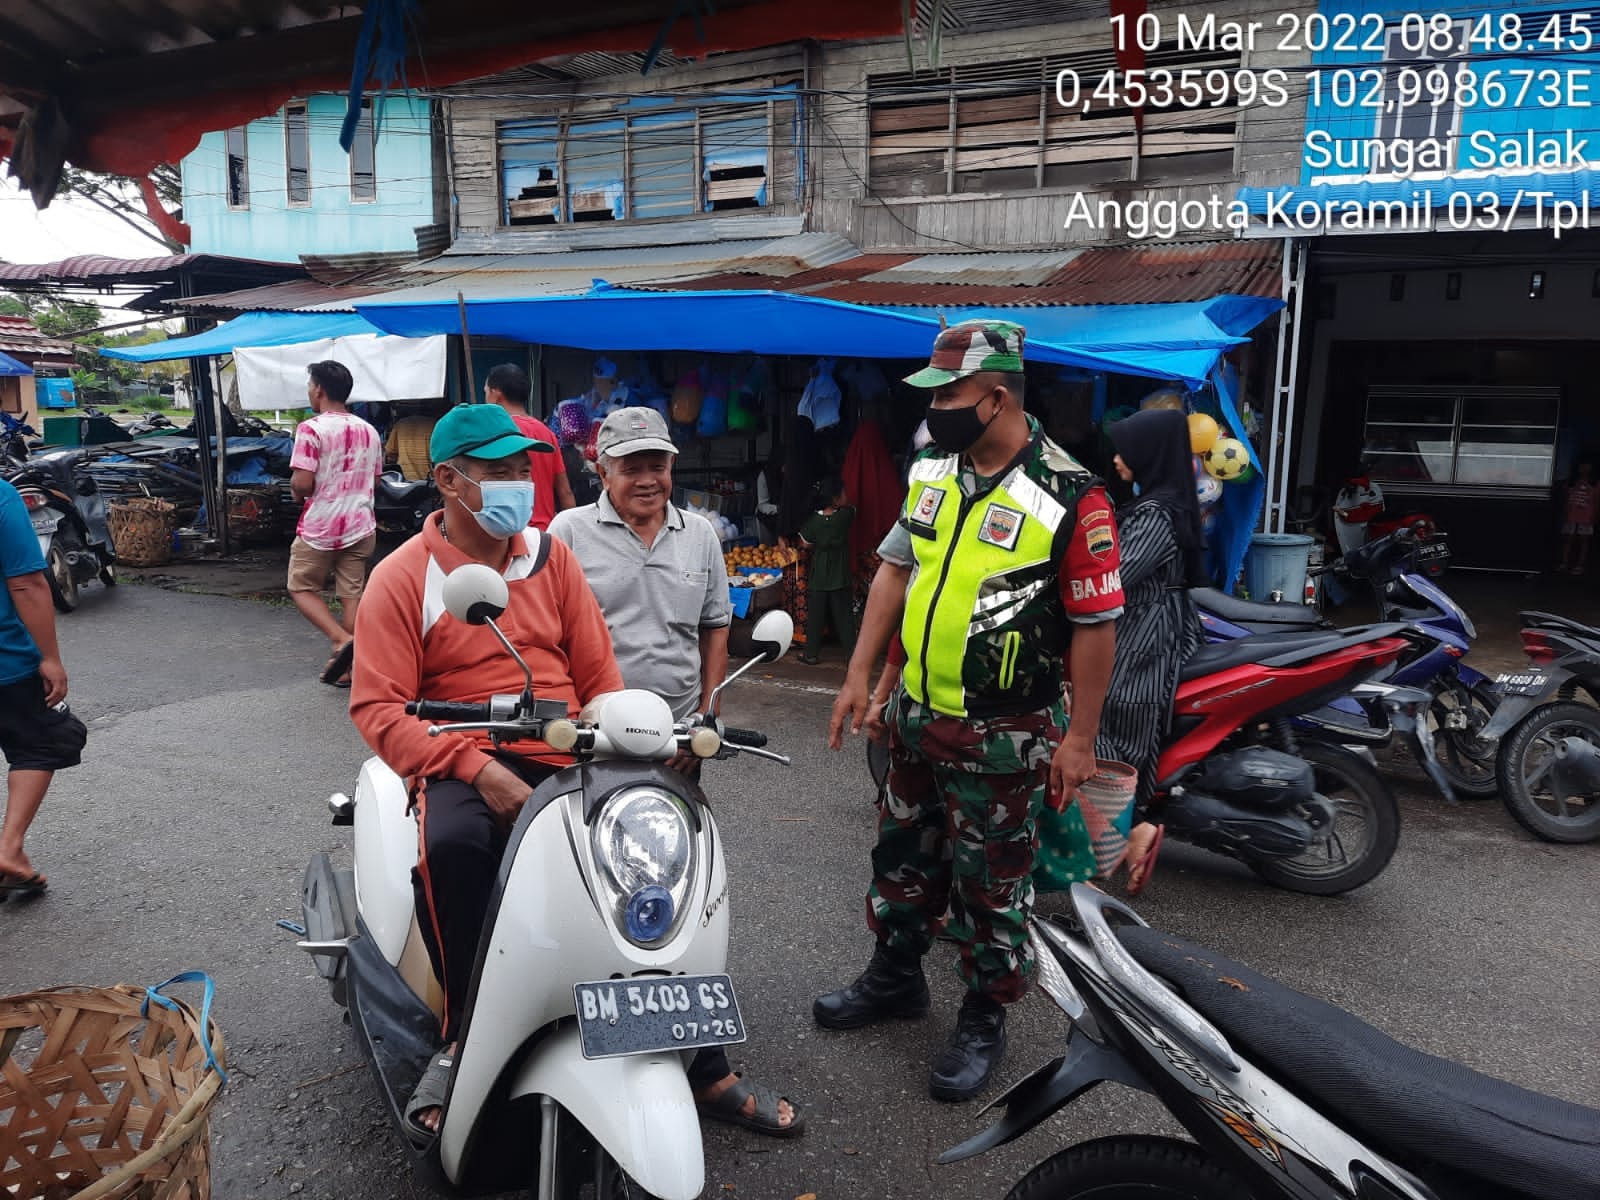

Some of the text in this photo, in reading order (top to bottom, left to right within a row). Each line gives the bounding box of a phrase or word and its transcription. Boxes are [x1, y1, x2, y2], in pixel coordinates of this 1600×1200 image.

[1071, 577, 1098, 601] BA
[625, 727, 661, 737] HONDA
[581, 982, 730, 1020] BM 5403 GS
